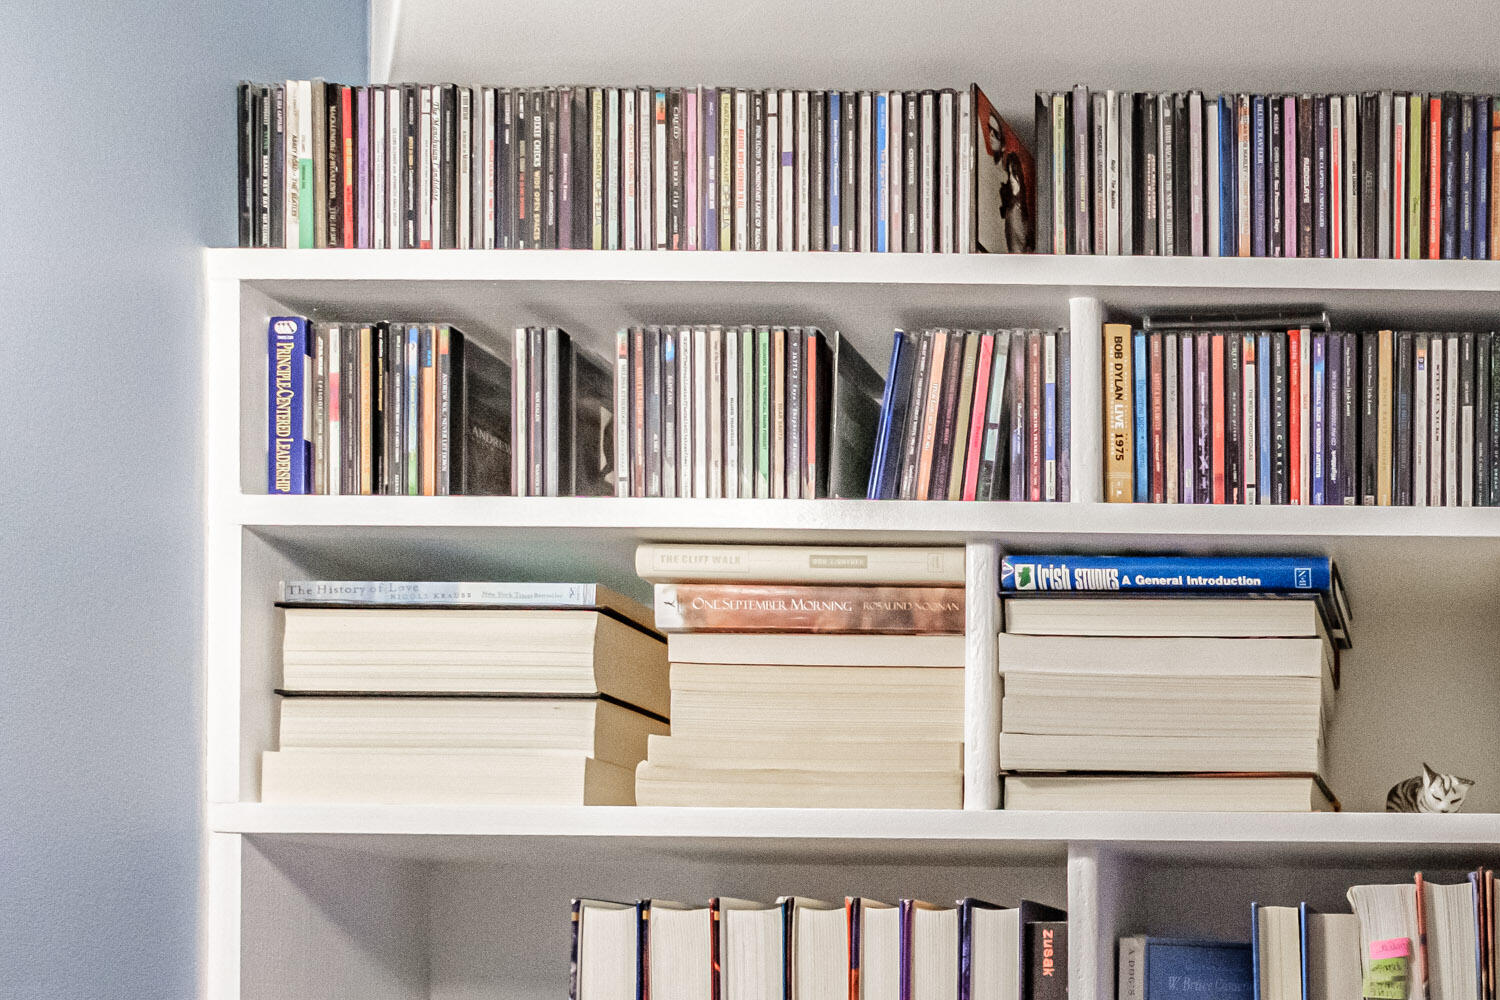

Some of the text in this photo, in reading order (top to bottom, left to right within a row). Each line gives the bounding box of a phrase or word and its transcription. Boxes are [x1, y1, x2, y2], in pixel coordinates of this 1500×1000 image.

[1115, 336, 1124, 461] BOB DYLAN LIVE 1975
[275, 342, 294, 491] PRINCIPLE-CENTERED LEADERSHIP
[660, 555, 741, 564] THE CLIFF WALK
[1038, 564, 1071, 590] Irish
[1122, 576, 1131, 586] A
[1135, 576, 1182, 586] General
[1186, 576, 1260, 586] Introduction
[287, 584, 419, 598] The History of Love
[693, 598, 959, 612] ONE SEPTEMBER MORNING ROSALIND NOONAN
[1042, 929, 1055, 976] zusak
